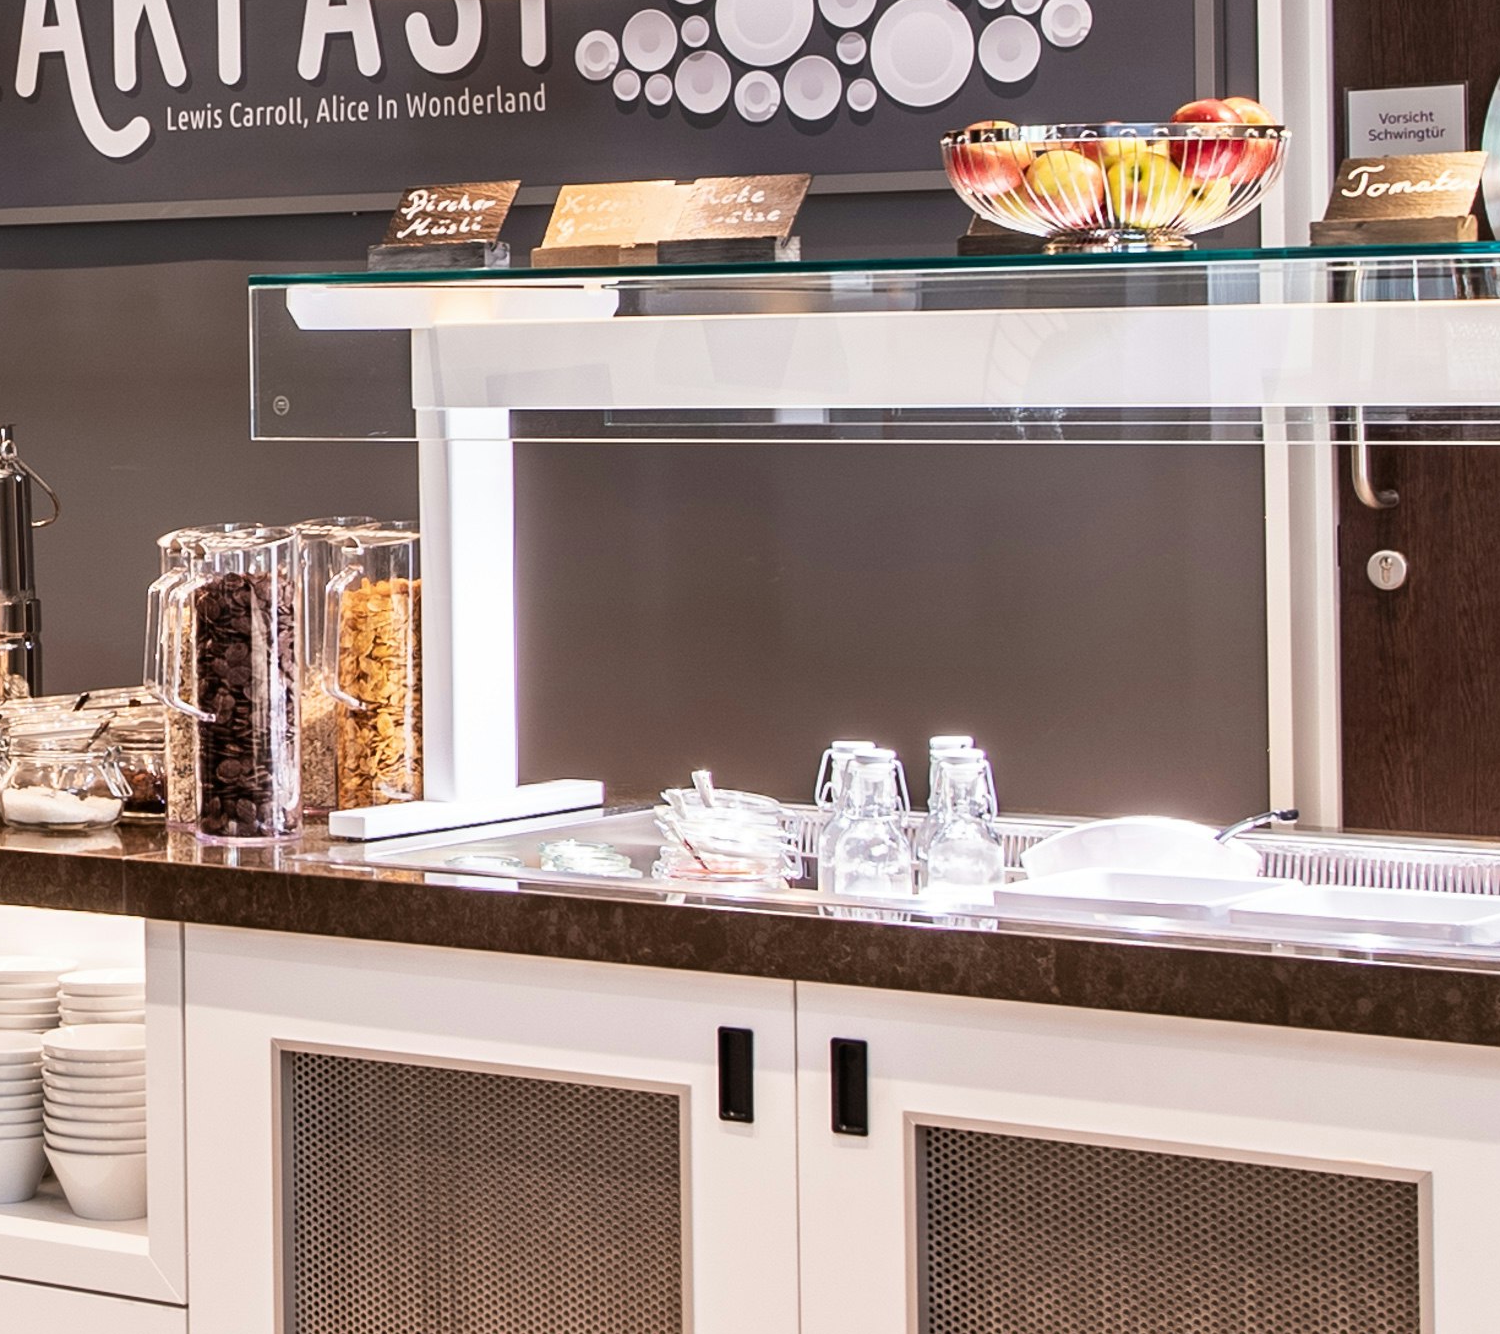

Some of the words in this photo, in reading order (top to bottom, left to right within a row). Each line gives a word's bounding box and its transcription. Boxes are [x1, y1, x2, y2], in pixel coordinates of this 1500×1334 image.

[166, 103, 223, 132] Lewis
[229, 97, 309, 129] Carroll,
[316, 95, 369, 123] Alice
[377, 94, 398, 120] In
[405, 82, 547, 120] Wonderland
[1378, 111, 1434, 125] Vorsicht
[1368, 126, 1446, 142] Schwingtür
